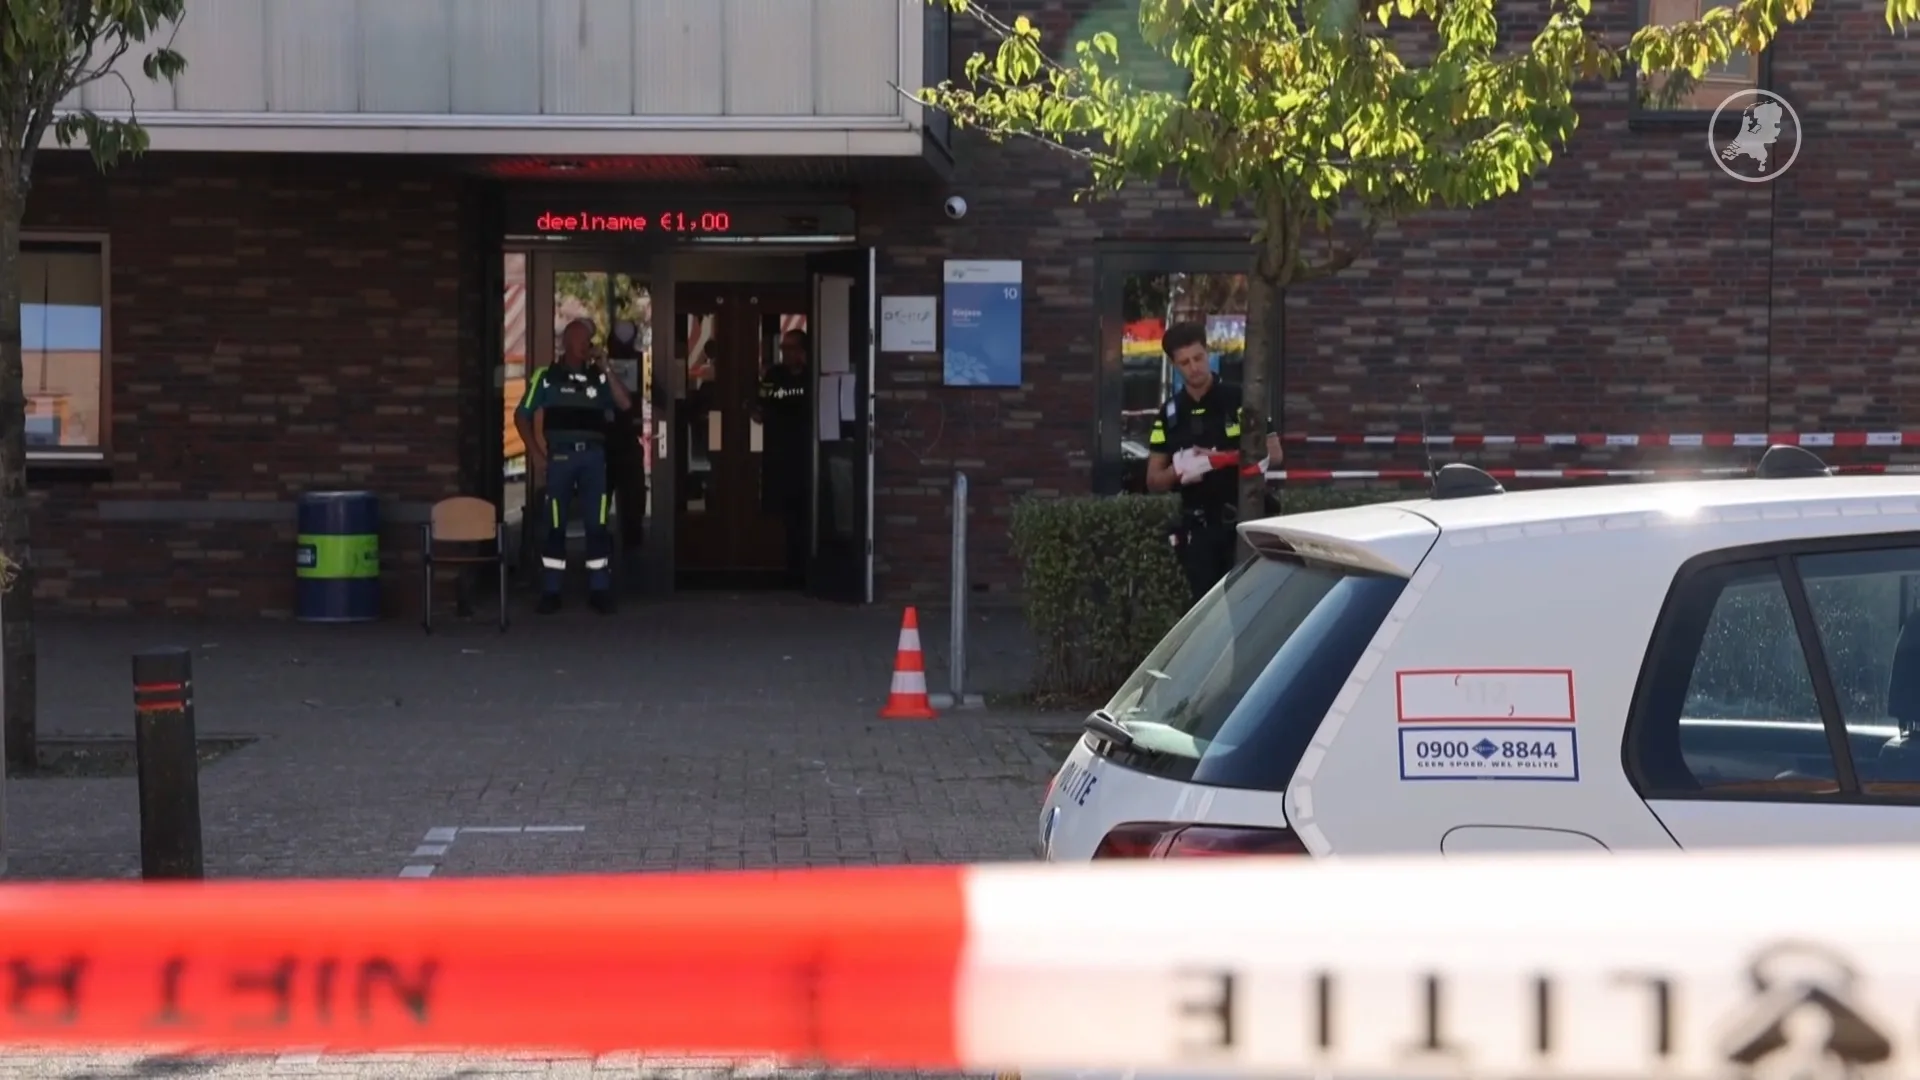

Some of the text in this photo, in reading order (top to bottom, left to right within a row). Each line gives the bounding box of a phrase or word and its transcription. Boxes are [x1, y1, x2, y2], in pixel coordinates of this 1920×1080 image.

[536, 212, 729, 231] deelname €1,00
[1002, 287, 1018, 300] 10
[1416, 741, 1469, 759] 0900
[1502, 741, 1557, 760] 8844
[1449, 761, 1487, 769] SPOED,
[1491, 761, 1513, 769] WEL
[1517, 761, 1559, 769] POLITIE
